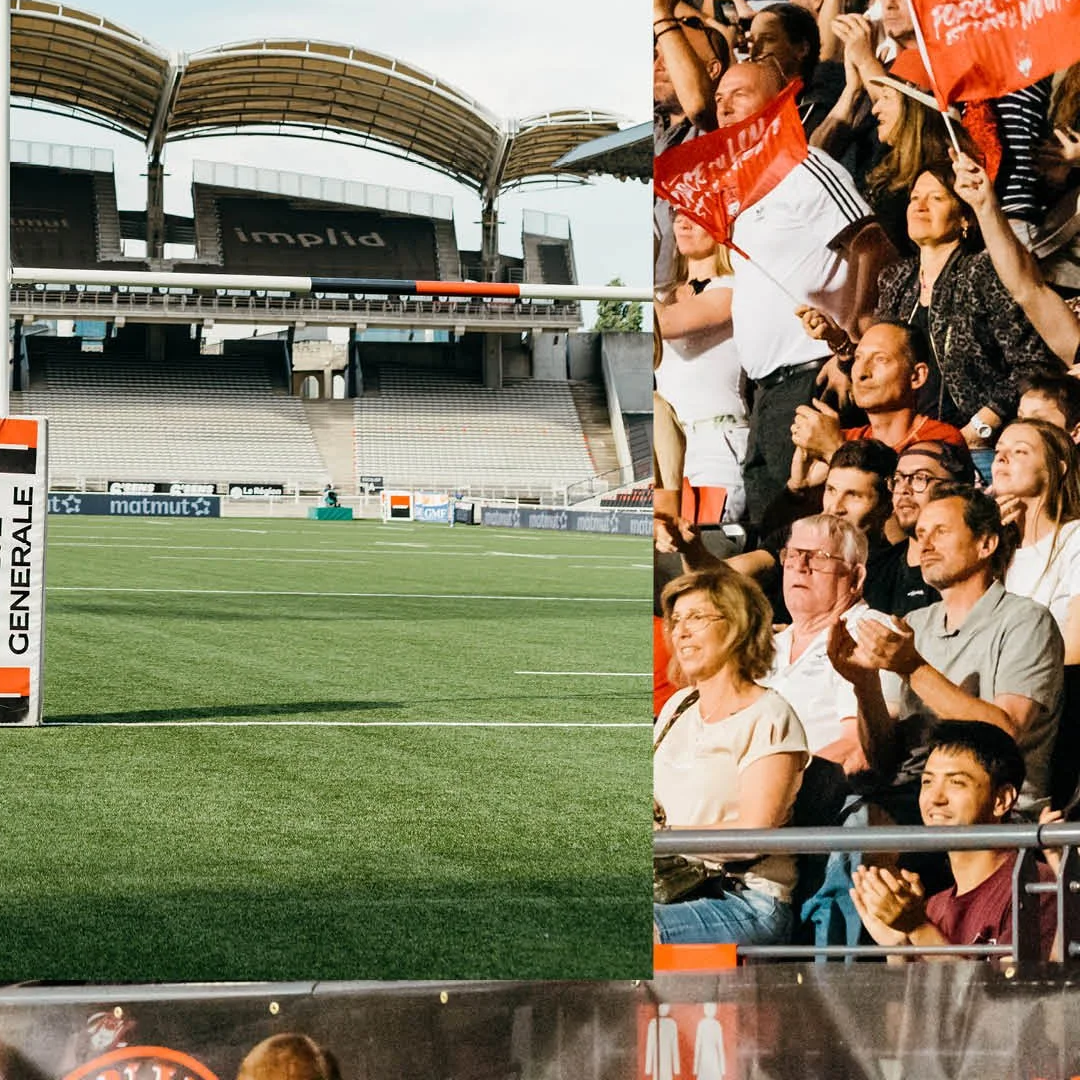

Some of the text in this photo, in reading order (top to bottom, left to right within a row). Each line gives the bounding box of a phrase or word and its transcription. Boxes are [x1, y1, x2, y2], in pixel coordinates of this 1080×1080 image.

[234, 227, 386, 248] implid
[110, 496, 191, 515] matmut
[9, 486, 34, 655] GENERALE
